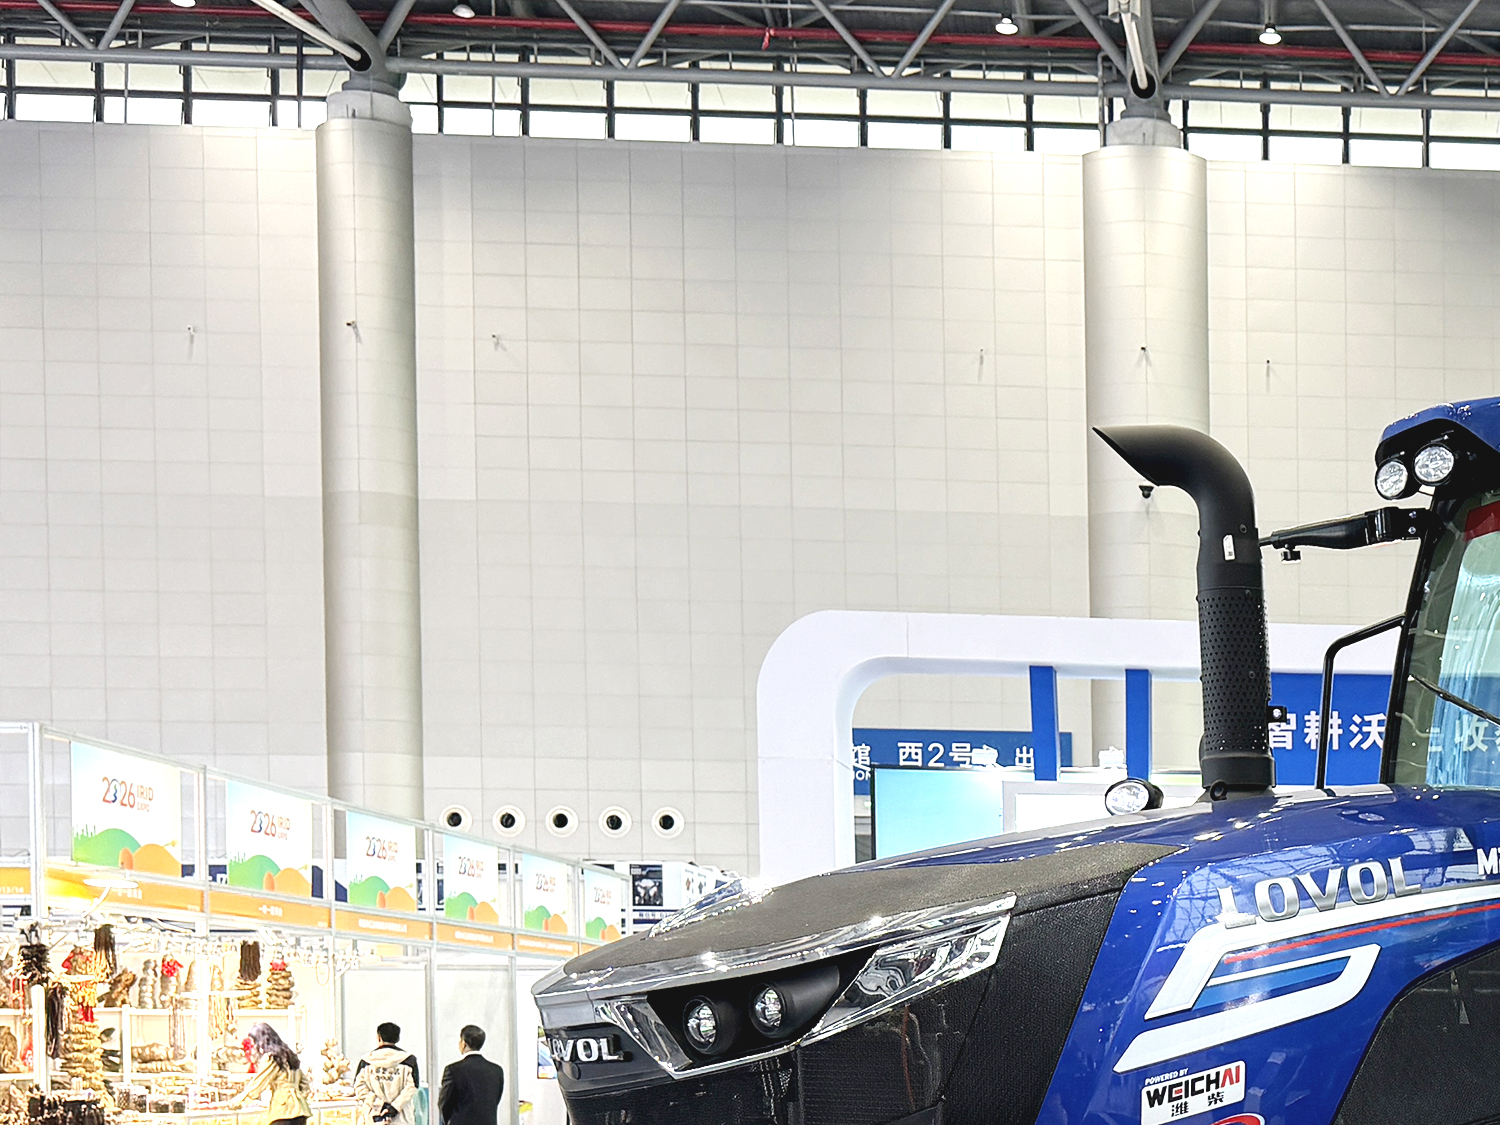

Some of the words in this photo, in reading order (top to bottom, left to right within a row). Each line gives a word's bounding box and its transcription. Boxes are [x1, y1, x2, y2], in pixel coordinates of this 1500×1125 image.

[1217, 856, 1422, 930] LOVOL
[1145, 1070, 1178, 1085] POWERED
[1178, 1067, 1189, 1077] BY
[1146, 1064, 1241, 1108] WEICHAI
[1171, 1091, 1225, 1118] 潍柴
